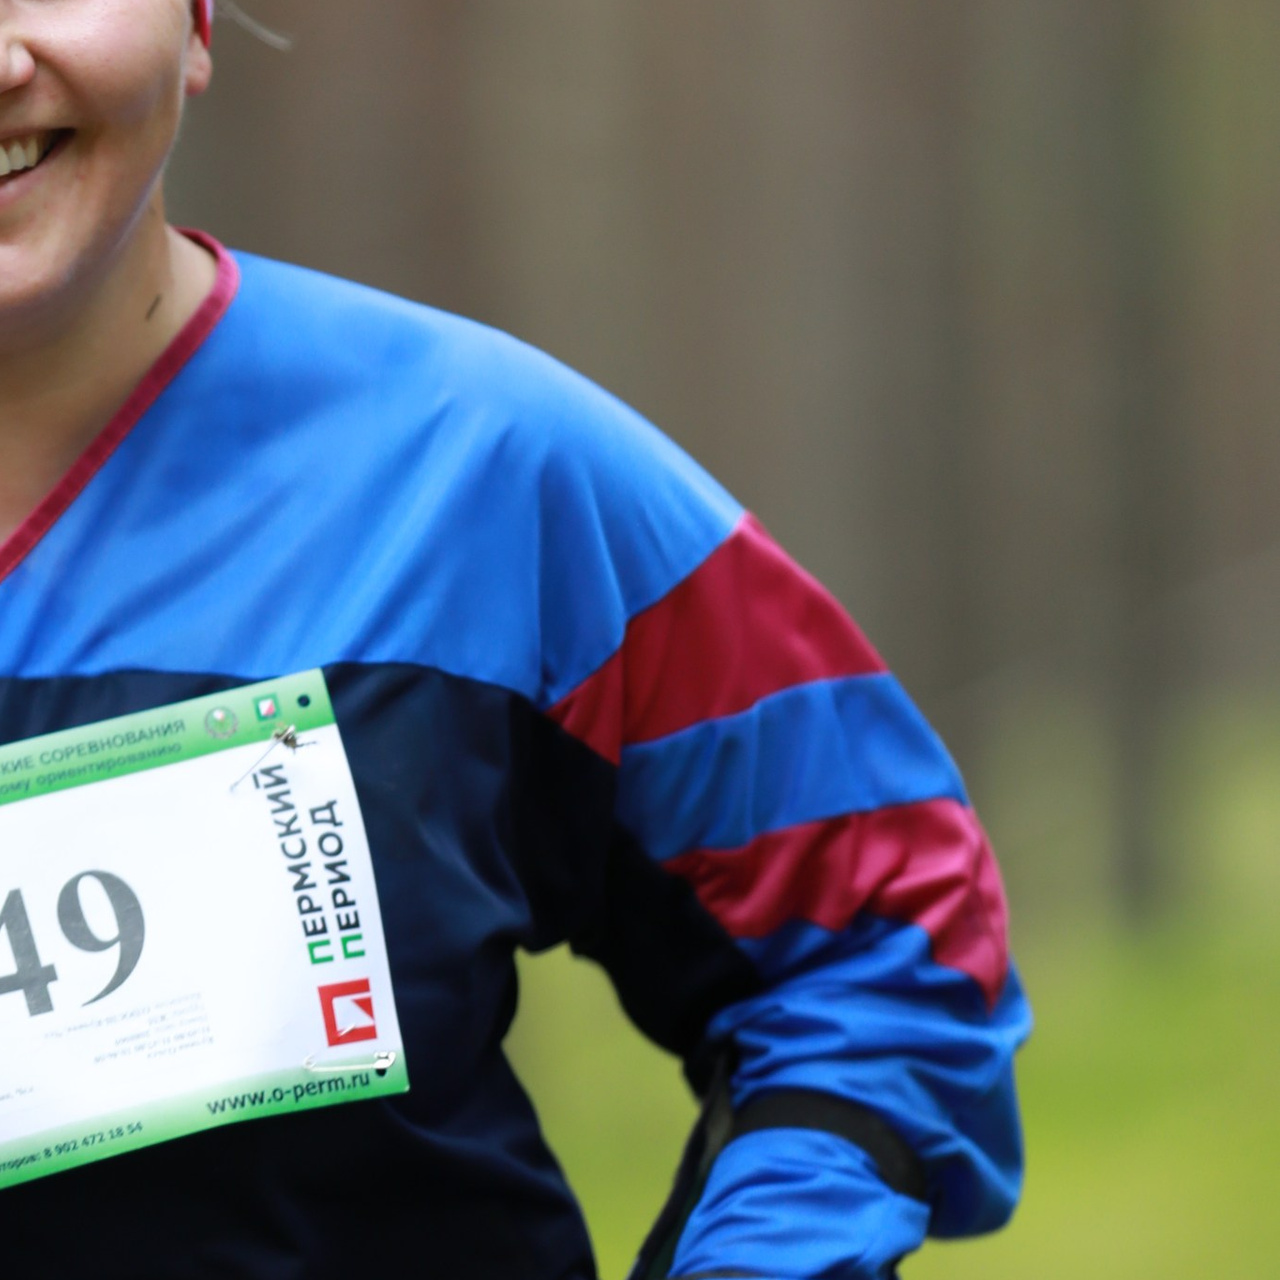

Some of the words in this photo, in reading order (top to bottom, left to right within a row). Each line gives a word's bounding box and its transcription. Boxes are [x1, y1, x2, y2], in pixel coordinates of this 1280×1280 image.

[35, 742, 182, 787] ориентированию
[39, 719, 185, 765] СОРЕВНОВАНИЯ
[251, 763, 334, 965] ПЕРМСКИЙ
[310, 799, 366, 959] ПЕРИОД
[208, 1071, 371, 1116] www.o-perm.ru
[54, 1138, 79, 1156] 902
[107, 1125, 124, 1140] 18
